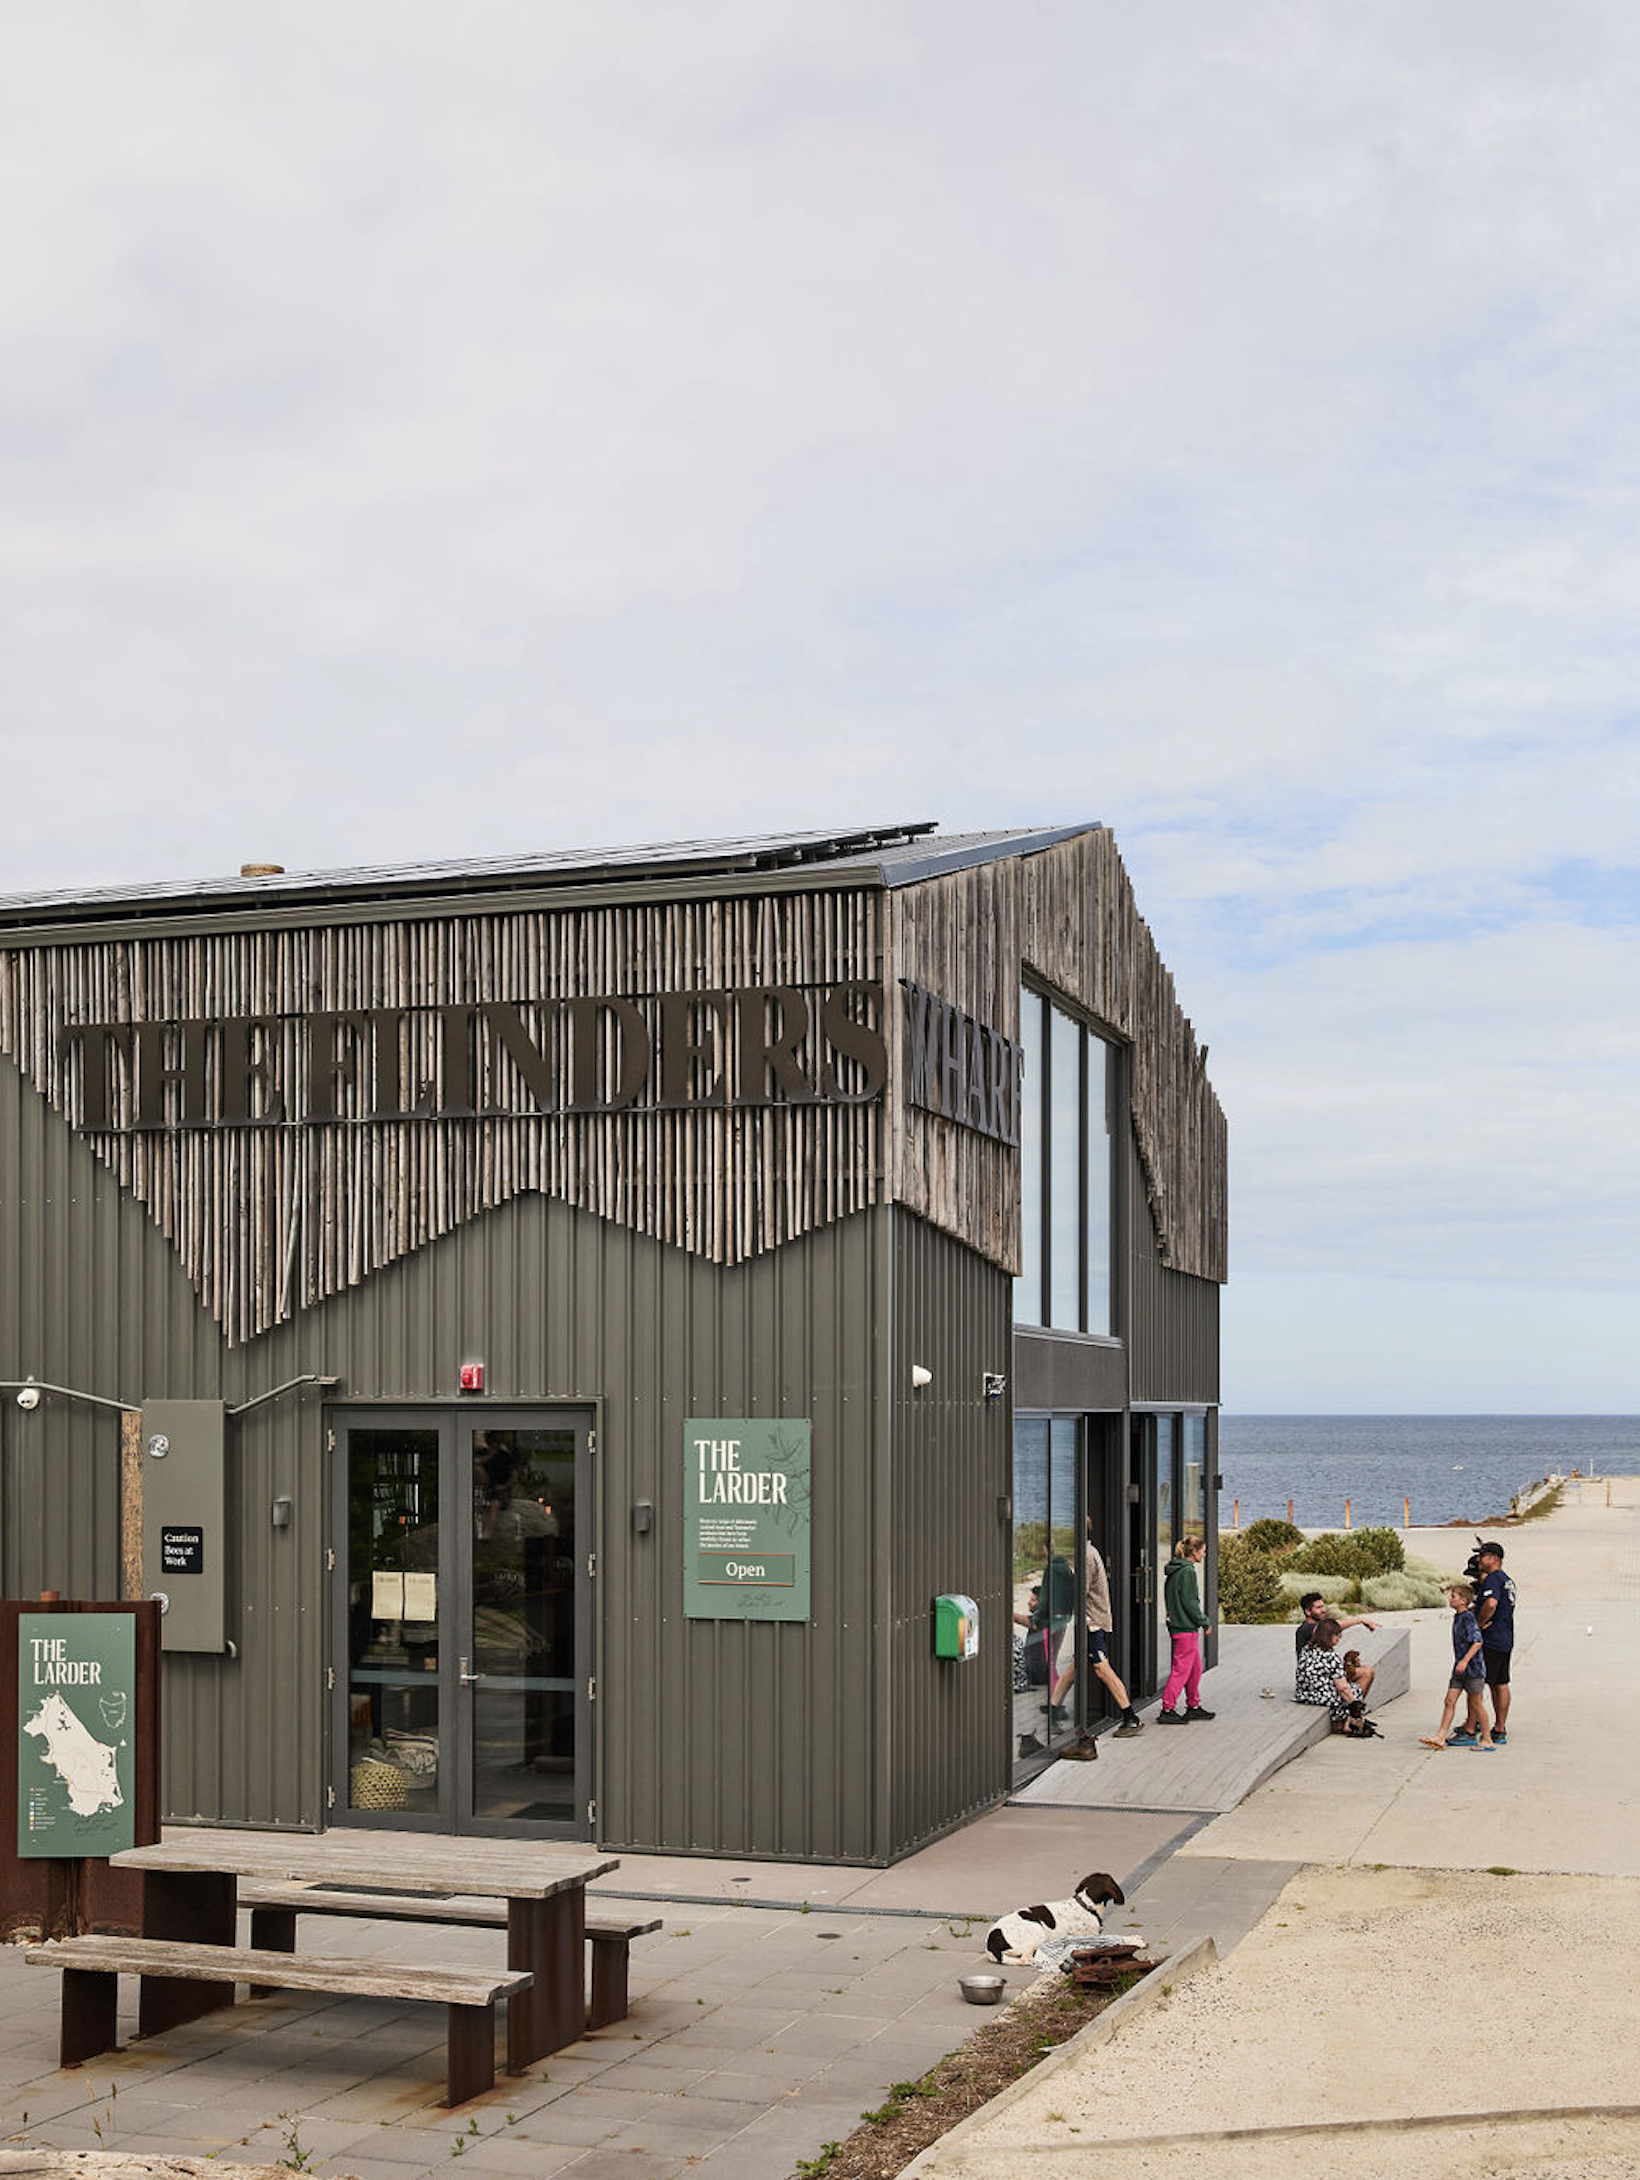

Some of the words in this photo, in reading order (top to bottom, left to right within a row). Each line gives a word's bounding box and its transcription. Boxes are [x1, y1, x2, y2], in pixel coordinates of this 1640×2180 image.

[59, 1017, 283, 1133] THE
[304, 979, 888, 1125] FLINDERS
[902, 981, 1025, 1148] WHARF
[694, 1440, 741, 1472] THE
[699, 1472, 788, 1505] LARDER
[164, 1533, 199, 1544] Caution
[164, 1556, 187, 1566] Work
[725, 1561, 766, 1579] Open
[30, 1638, 68, 1662] THE
[34, 1661, 102, 1685] LARDER
